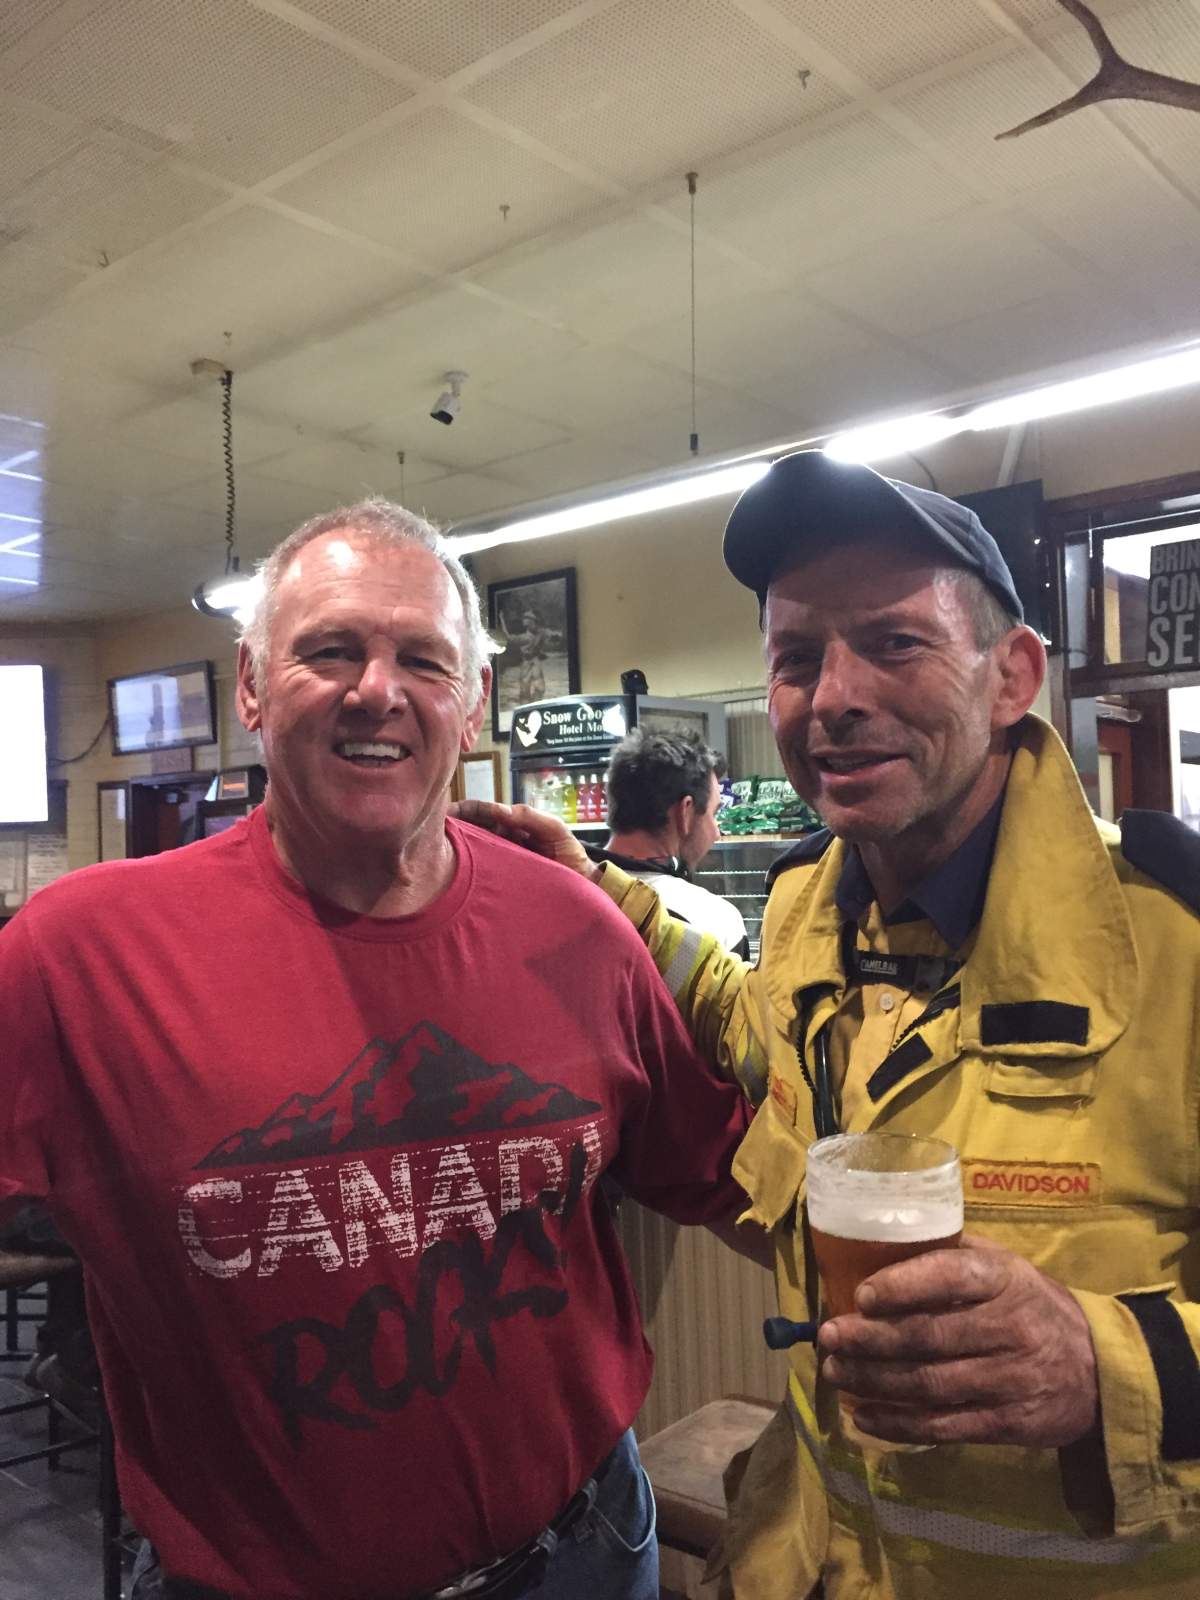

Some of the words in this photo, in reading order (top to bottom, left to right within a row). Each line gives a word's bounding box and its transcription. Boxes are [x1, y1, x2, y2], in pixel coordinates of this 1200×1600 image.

[1147, 611, 1200, 668] SE
[543, 711, 572, 725] Snow
[576, 705, 607, 721] Goo
[559, 723, 583, 736] Hotel
[587, 721, 605, 733] Mo
[972, 1172, 1090, 1194] DAVIDSON
